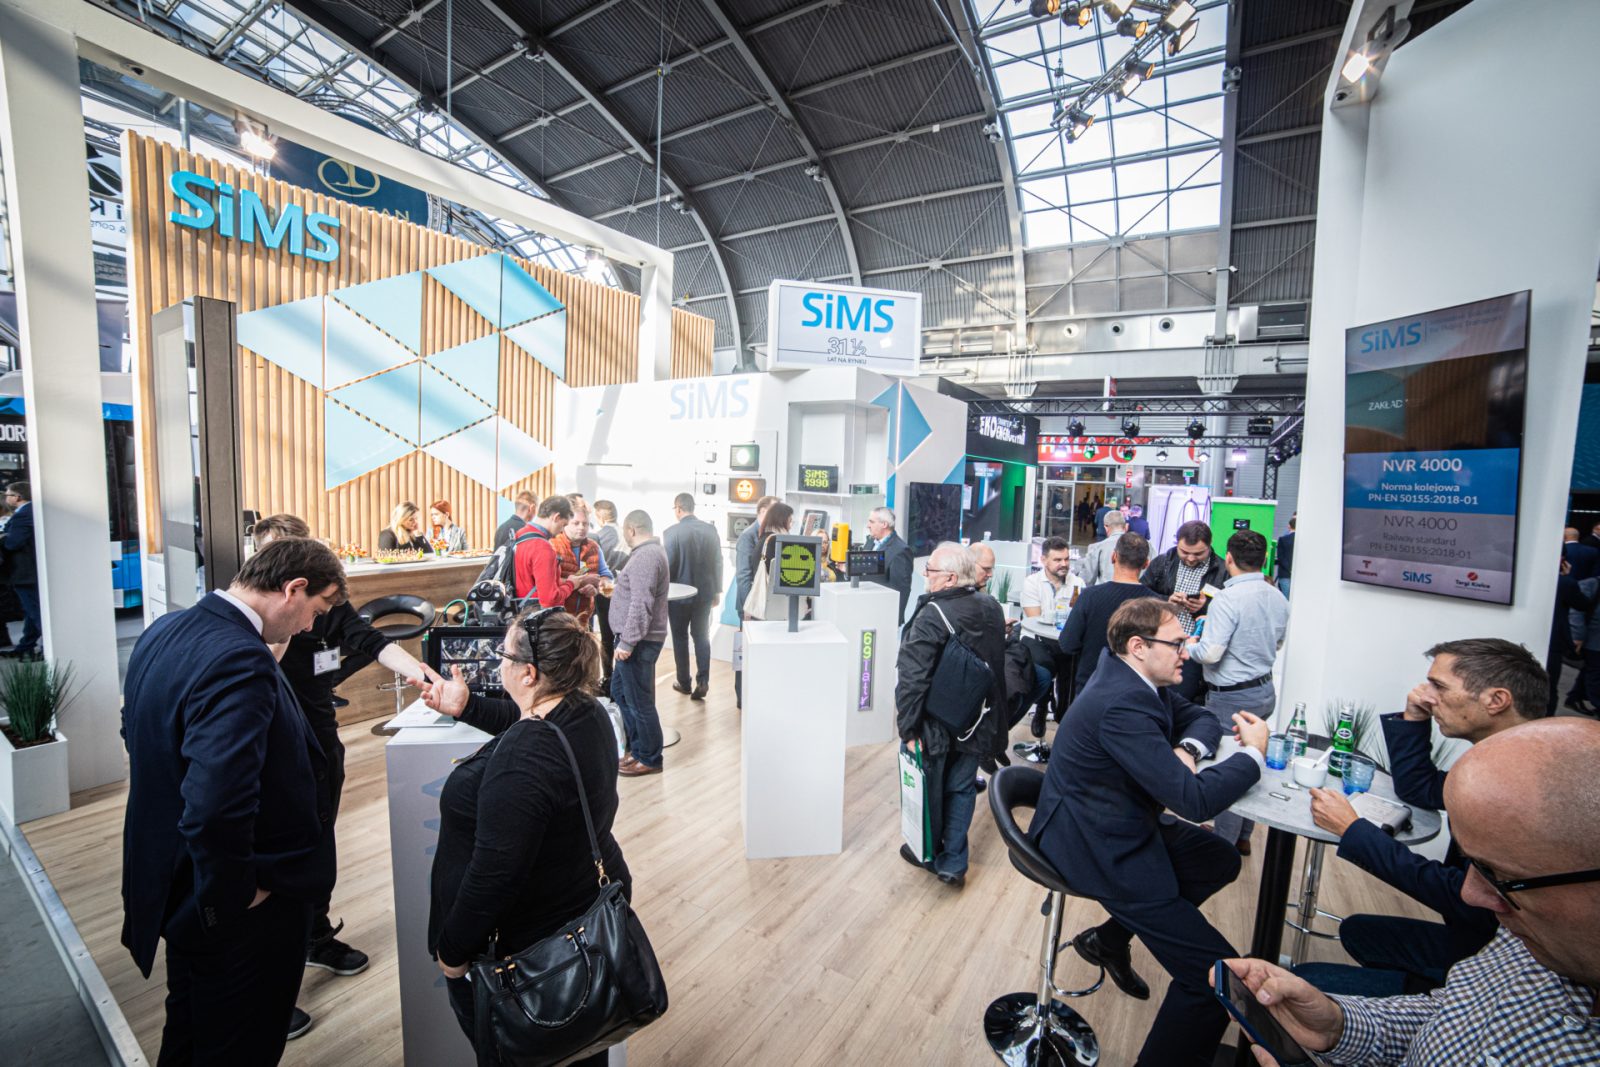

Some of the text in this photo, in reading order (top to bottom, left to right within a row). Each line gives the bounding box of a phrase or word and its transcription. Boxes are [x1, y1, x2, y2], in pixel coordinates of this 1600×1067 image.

[169, 170, 340, 262] SiMS
[801, 292, 895, 334] SiMS
[1361, 322, 1422, 353] SiMS
[670, 378, 750, 420] SiMS
[1383, 458, 1463, 472] NVR 4000
[804, 479, 829, 488] 1990
[1381, 483, 1460, 493] Norma kolejowa
[1368, 493, 1479, 505] PN-EN 50155:2018-01
[1384, 515, 1458, 531] NVR 4000
[1416, 536, 1456, 546] standard
[1402, 570, 1432, 585] SiMS
